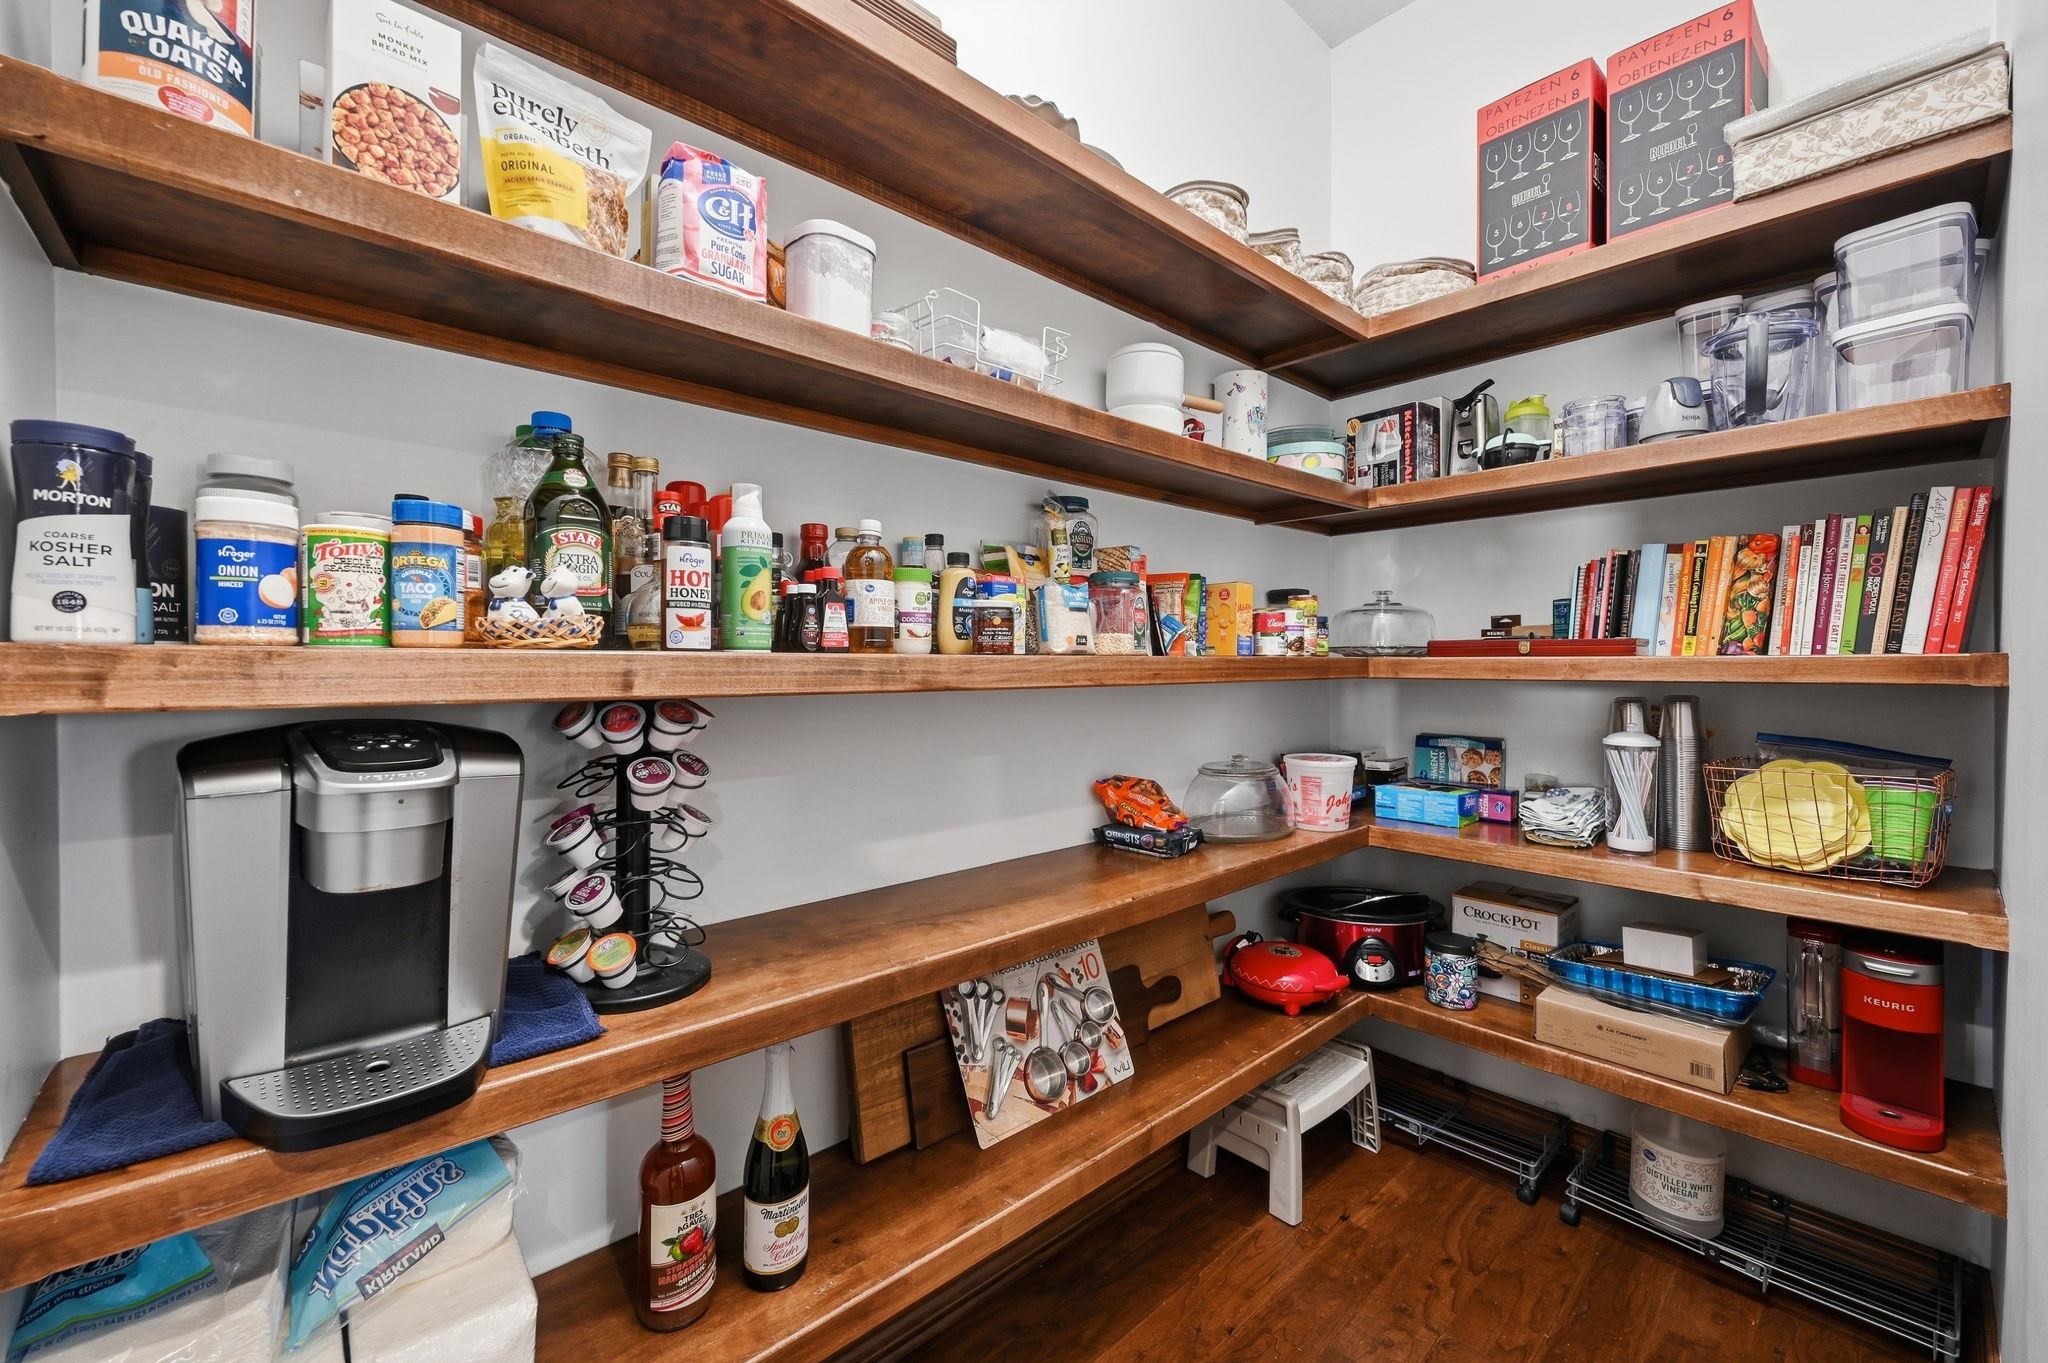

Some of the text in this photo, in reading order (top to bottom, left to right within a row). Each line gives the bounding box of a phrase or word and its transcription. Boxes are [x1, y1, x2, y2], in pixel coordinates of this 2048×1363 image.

[378, 32, 422, 54] MONKEY
[1619, 9, 1734, 67] PAYEZ-EN 6
[149, 37, 223, 84] OATS
[371, 39, 406, 57] BREAD
[409, 55, 428, 66] MIX
[1618, 29, 1733, 86] OBTENEZ-EN 8
[138, 65, 162, 80] OLD
[166, 72, 229, 110] FASHIONED
[1486, 69, 1580, 120] PAYEZ-EN 6
[1628, 67, 1724, 112] 1 2 3 4
[491, 82, 578, 136] purely
[1486, 89, 1580, 137] OBTENEZ-EN 8
[493, 101, 610, 170] elizabeth
[503, 133, 537, 144] ORGANIC
[1494, 154, 1498, 162] 1
[1566, 123, 1572, 131] 4
[501, 160, 555, 176] ORIGINAL
[1628, 154, 1724, 195] 5 6 7 8
[1494, 229, 1500, 237] 5
[1517, 221, 1523, 229] 6
[1541, 211, 1547, 220] 7
[711, 240, 747, 262] Pure Cane
[702, 249, 751, 275] GRANULATED
[711, 262, 745, 285] SUGAR
[33, 488, 111, 509] MORTON
[659, 503, 682, 513] STAR
[44, 530, 95, 541] COARSE
[557, 531, 599, 548] STAR
[741, 531, 772, 540] PRIMA
[29, 540, 112, 556] KOSHER
[218, 545, 255, 562] Kroger
[316, 541, 384, 560] Tony's
[1826, 547, 1837, 566] Style
[43, 555, 96, 567] SALT
[334, 557, 371, 566] CREOLE
[392, 555, 449, 571] ORTEGA
[559, 553, 598, 566] EXTRA
[679, 553, 705, 567] Kroger
[1840, 553, 1849, 563] FIX
[1853, 554, 1866, 562] 30
[1869, 552, 1885, 575] 100
[218, 564, 258, 578] ONION
[323, 564, 382, 575] SEASONING
[401, 570, 433, 579] ORIGINAL
[670, 570, 710, 587] HOT
[1692, 557, 1703, 581] Gourmet
[1891, 516, 1921, 634] WOMEN OF GREAT TASTE
[400, 583, 436, 594] TACO
[1822, 573, 1834, 594] Home
[1836, 574, 1846, 595] FREEZE
[1866, 576, 1874, 592] MAKE
[670, 587, 710, 600] HONEY
[1690, 582, 1700, 605] Cooking
[153, 602, 181, 613] SALT
[1622, 595, 1631, 619] FESTIVE
[1831, 624, 1839, 636] EAT
[1078, 952, 1100, 981] 10
[1863, 995, 1916, 1013] KEURIG
[1646, 1166, 1713, 1193] DISTILLED WHITE
[1661, 1181, 1698, 1199] VINEGAR
[677, 1214, 708, 1234] AGAVES
[684, 1208, 703, 1222] TRES
[763, 1228, 806, 1254] Sparkling
[79, 1277, 115, 1295] strong
